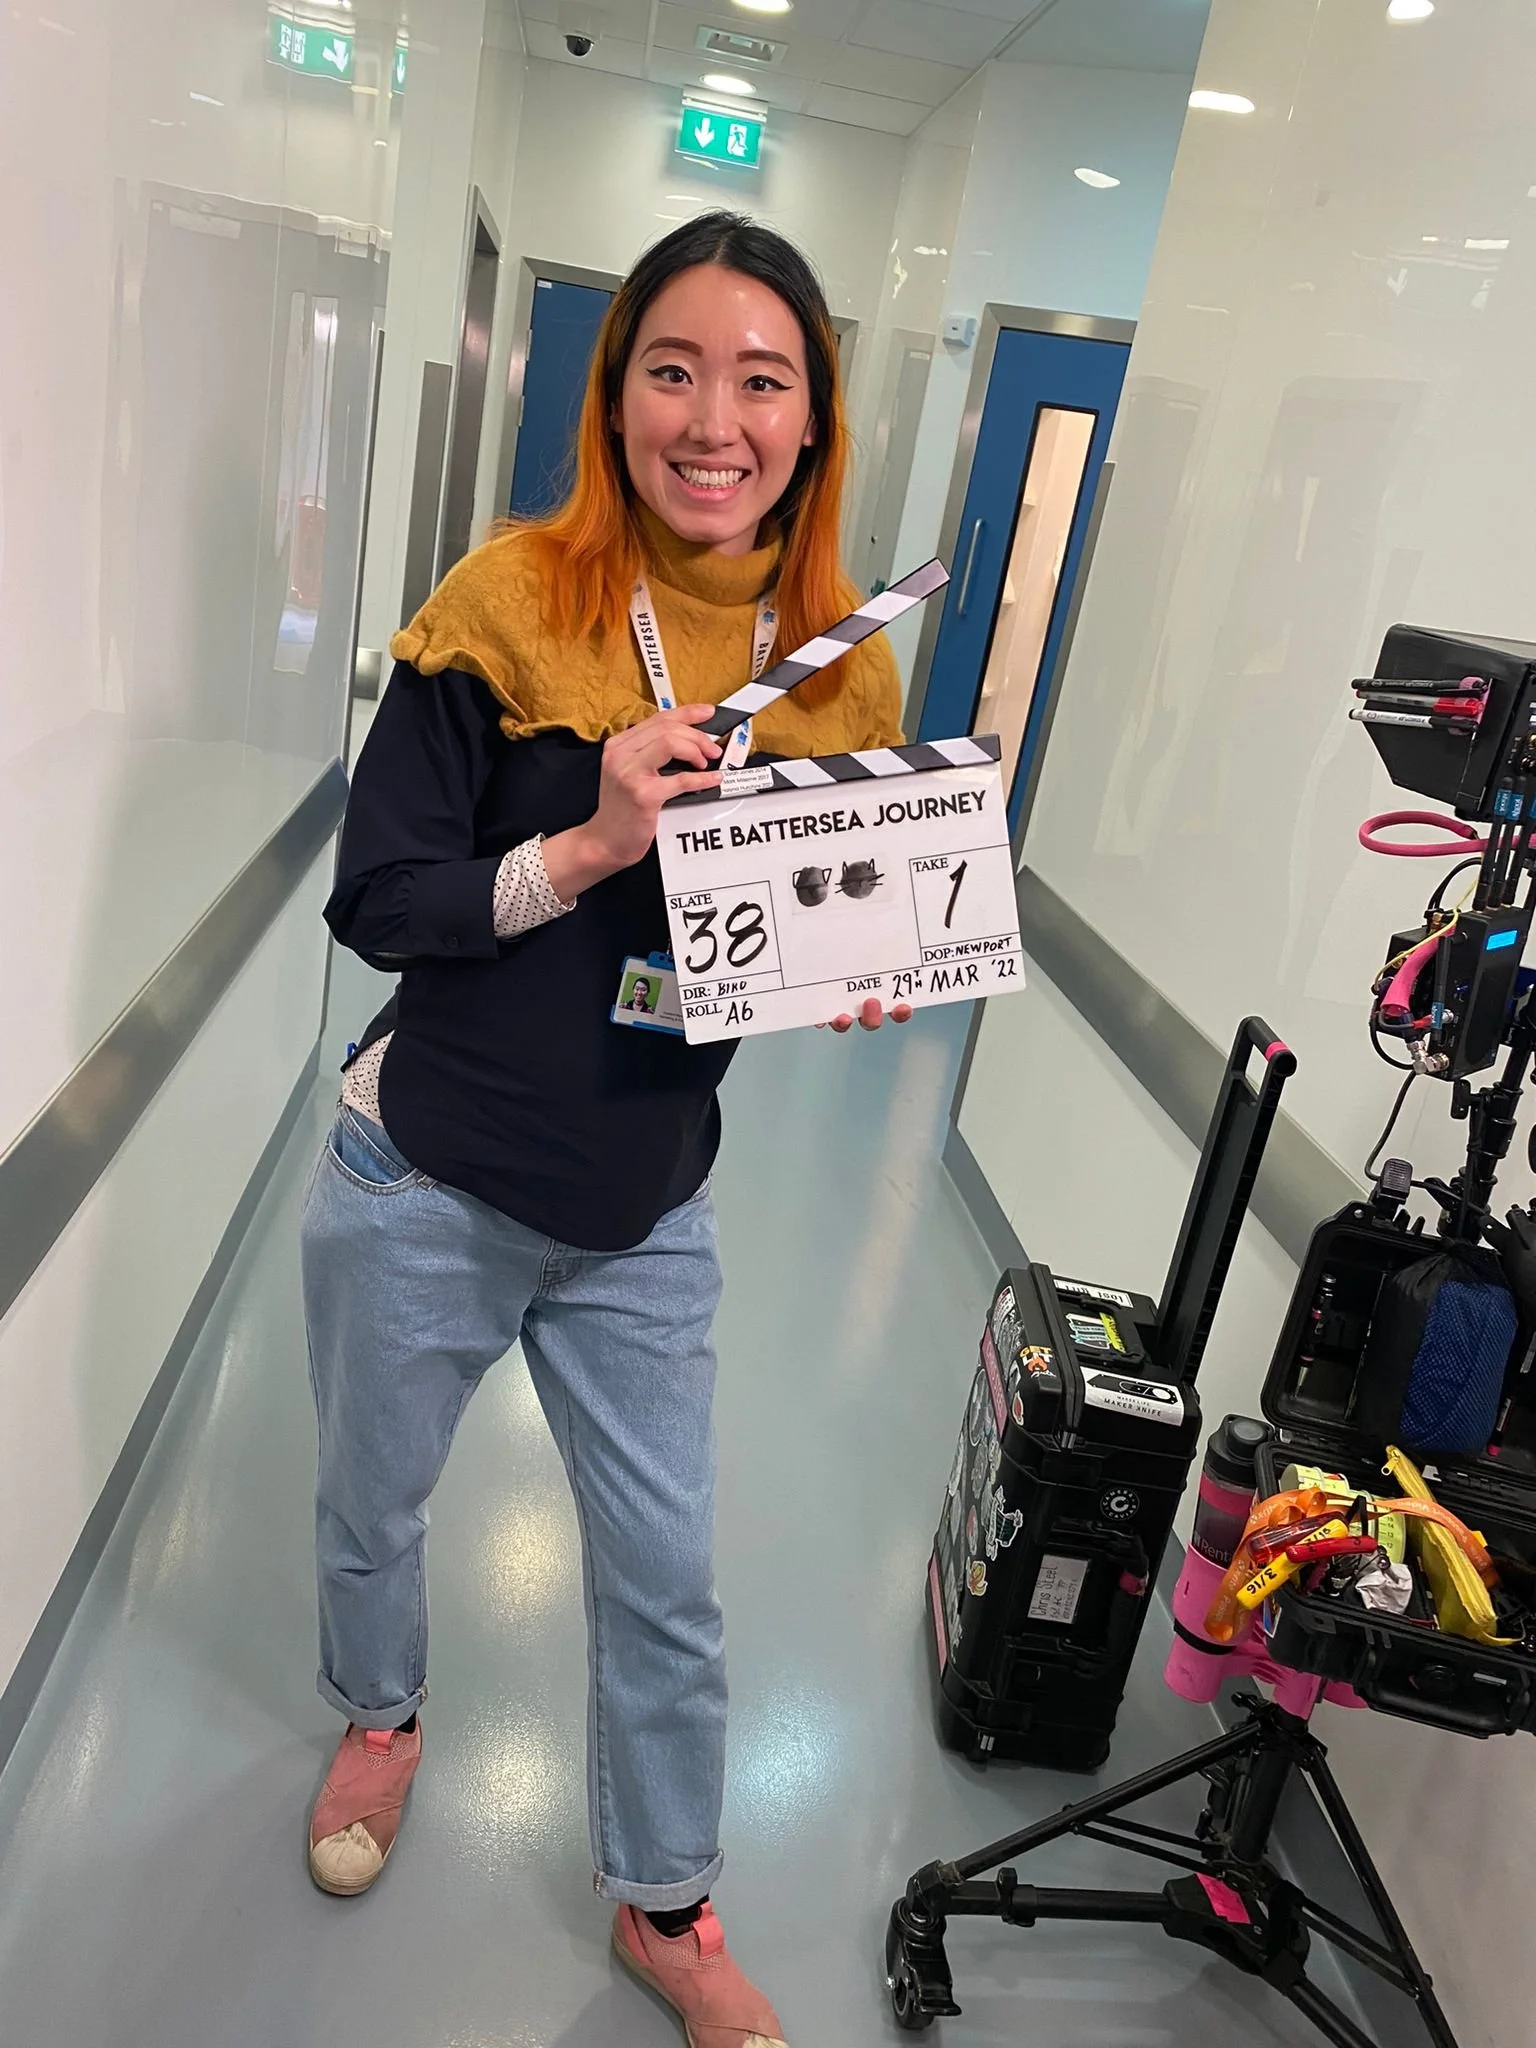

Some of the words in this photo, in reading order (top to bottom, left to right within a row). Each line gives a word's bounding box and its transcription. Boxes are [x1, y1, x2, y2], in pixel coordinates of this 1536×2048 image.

[637, 612, 664, 678] BATTERSEA
[676, 828, 723, 855] THE
[730, 808, 864, 848] BATTERSEA
[873, 790, 986, 828] JOURNEY
[912, 857, 949, 873] TAKE
[670, 893, 713, 910] SLATE
[944, 859, 968, 929] 1
[682, 901, 768, 974] 38
[924, 949, 955, 962] DOP:
[955, 936, 1013, 956] NEWPORT
[846, 977, 882, 993] DATE
[930, 963, 980, 993] MAR
[683, 986, 711, 1000] DIR:
[685, 1003, 723, 1019] ROLL
[725, 1000, 753, 1026] A6
[1019, 1345, 1053, 1358] GET
[1104, 1398, 1133, 1409] MAKER
[1246, 1567, 1278, 1595] 3/16
[1031, 1592, 1052, 1616] Chris
